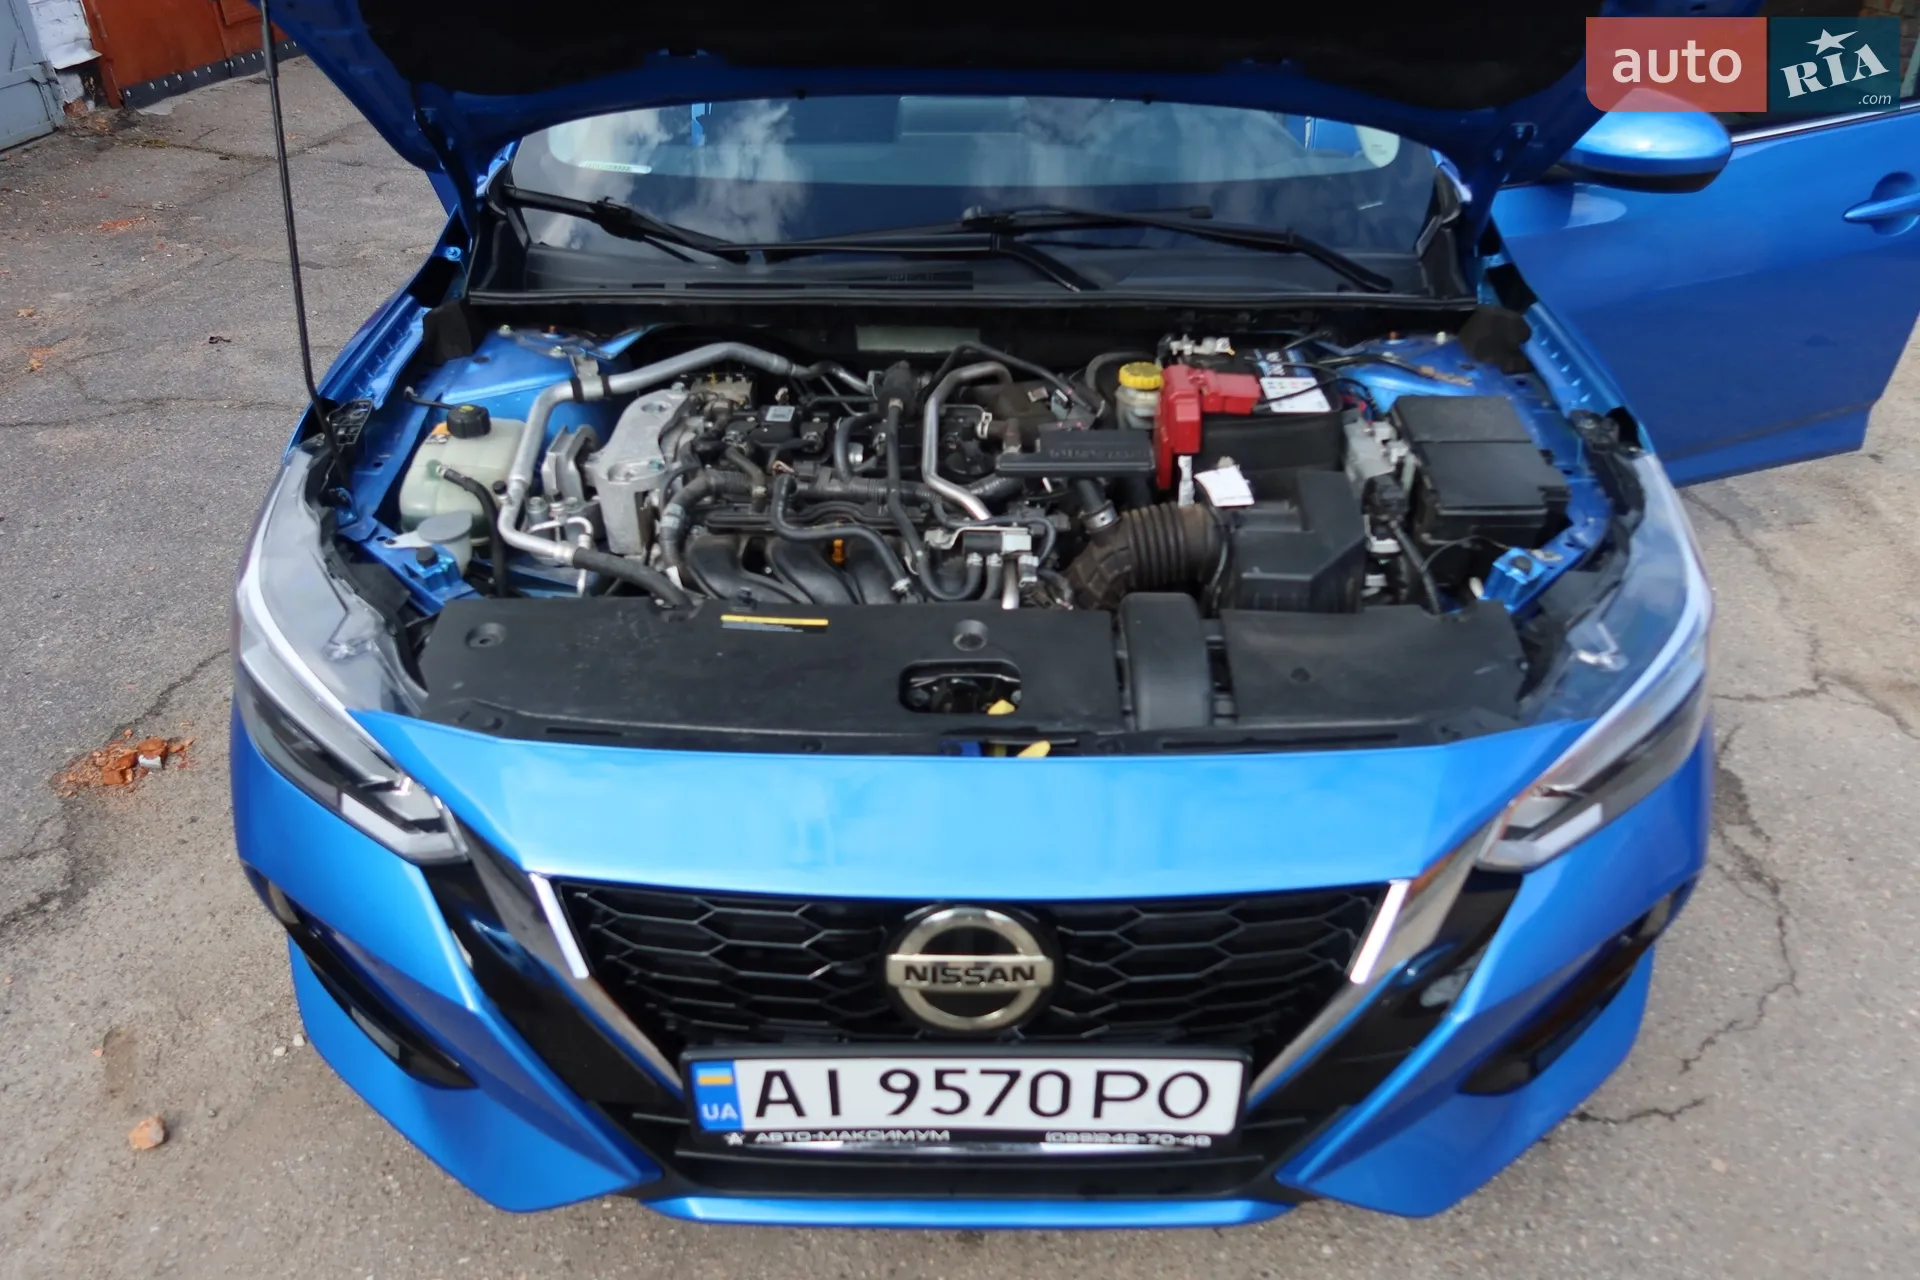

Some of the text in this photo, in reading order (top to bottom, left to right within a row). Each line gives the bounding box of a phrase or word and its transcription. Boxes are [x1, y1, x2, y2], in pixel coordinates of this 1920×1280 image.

[904, 965, 1036, 984] NISSAN
[755, 1070, 841, 1118] AI
[879, 1068, 1072, 1117] 9570
[701, 1102, 739, 1121] UA
